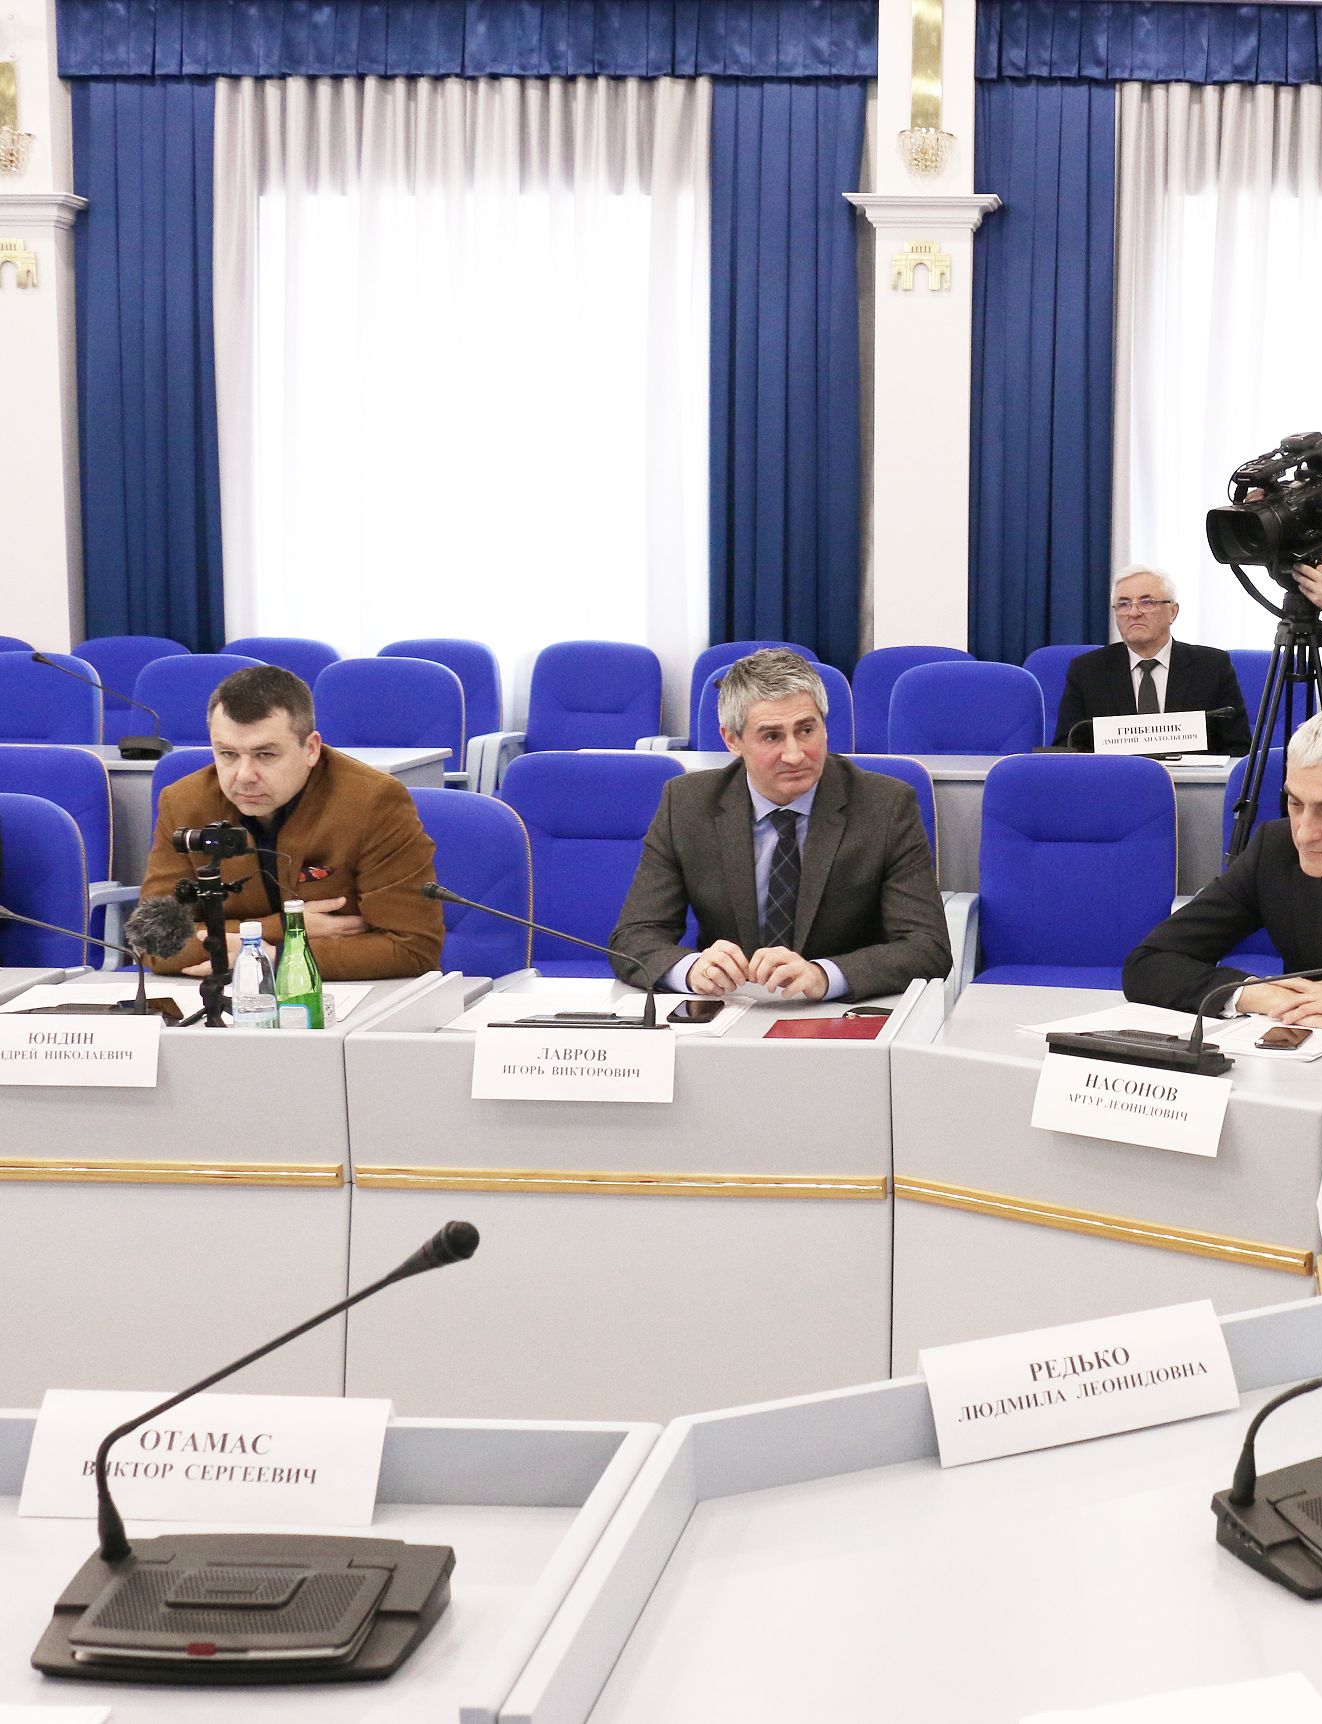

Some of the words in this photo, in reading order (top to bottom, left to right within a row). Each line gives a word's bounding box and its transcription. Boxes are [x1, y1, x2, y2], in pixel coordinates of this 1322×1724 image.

[1118, 724, 1182, 735] ГРИБЕННИК
[1102, 737, 1140, 746] ДМИТРИЙ
[1144, 734, 1198, 744] АНАТОЛЬЕВИЧ
[28, 1032, 94, 1046] ЮНДИН
[45, 1050, 133, 1060] НИКОЛАЕВИЧ
[537, 1047, 607, 1061] ЛАВРОВ
[503, 1064, 545, 1075] ИГОРЬ
[551, 1066, 641, 1078] ВИКТОРОВИЧ
[1085, 1073, 1179, 1102] НАСОНОВ
[1067, 1093, 1104, 1107] АРТУР
[1104, 1099, 1189, 1122] ЛЕОНИДОВИЧ
[1028, 1346, 1131, 1382] РЕДЬКО
[958, 1388, 1067, 1422] ЛЮДМИЛА
[1076, 1361, 1208, 1399] ЛЕОНИДОВНА
[139, 1429, 273, 1456] ОТАМАС
[184, 1463, 319, 1485] СЕРГЕЕВИЧ
